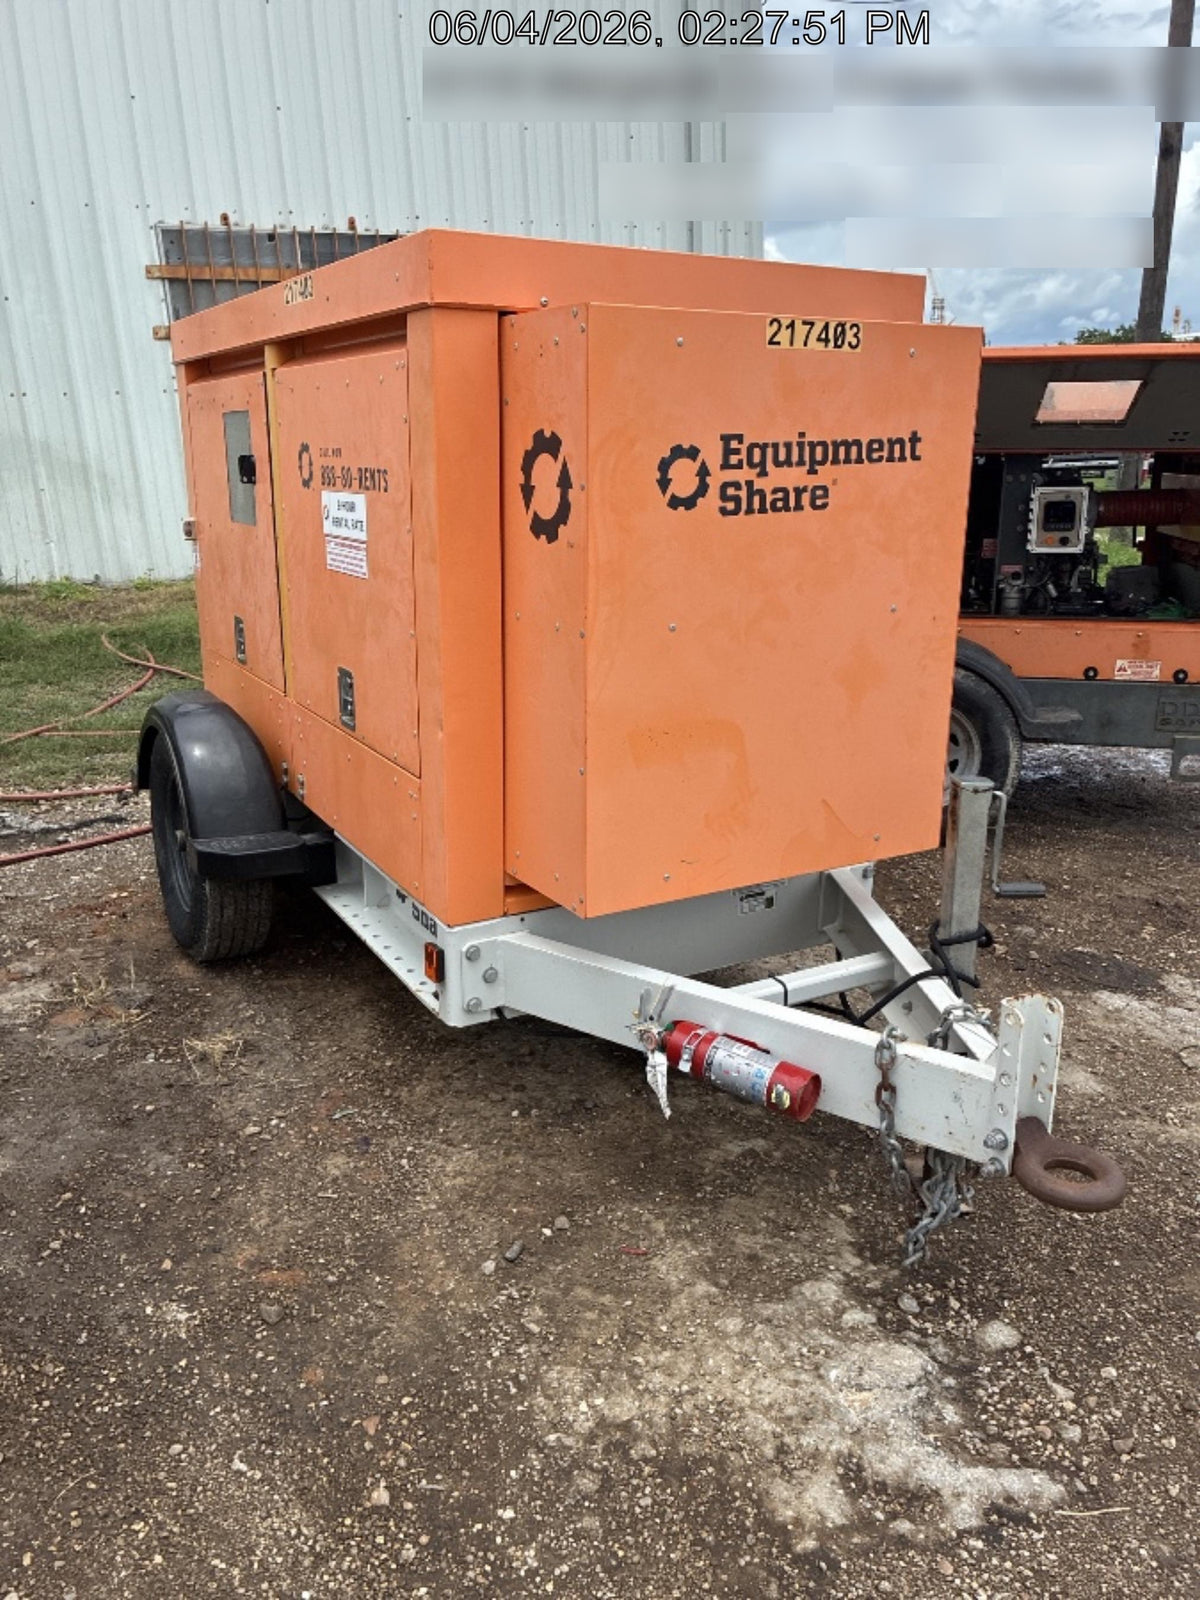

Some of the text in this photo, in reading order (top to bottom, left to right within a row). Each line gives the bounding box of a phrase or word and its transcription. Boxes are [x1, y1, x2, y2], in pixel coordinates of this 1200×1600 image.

[767, 317, 862, 350] 217403
[720, 431, 922, 477] Equipment
[718, 479, 830, 517] Share
